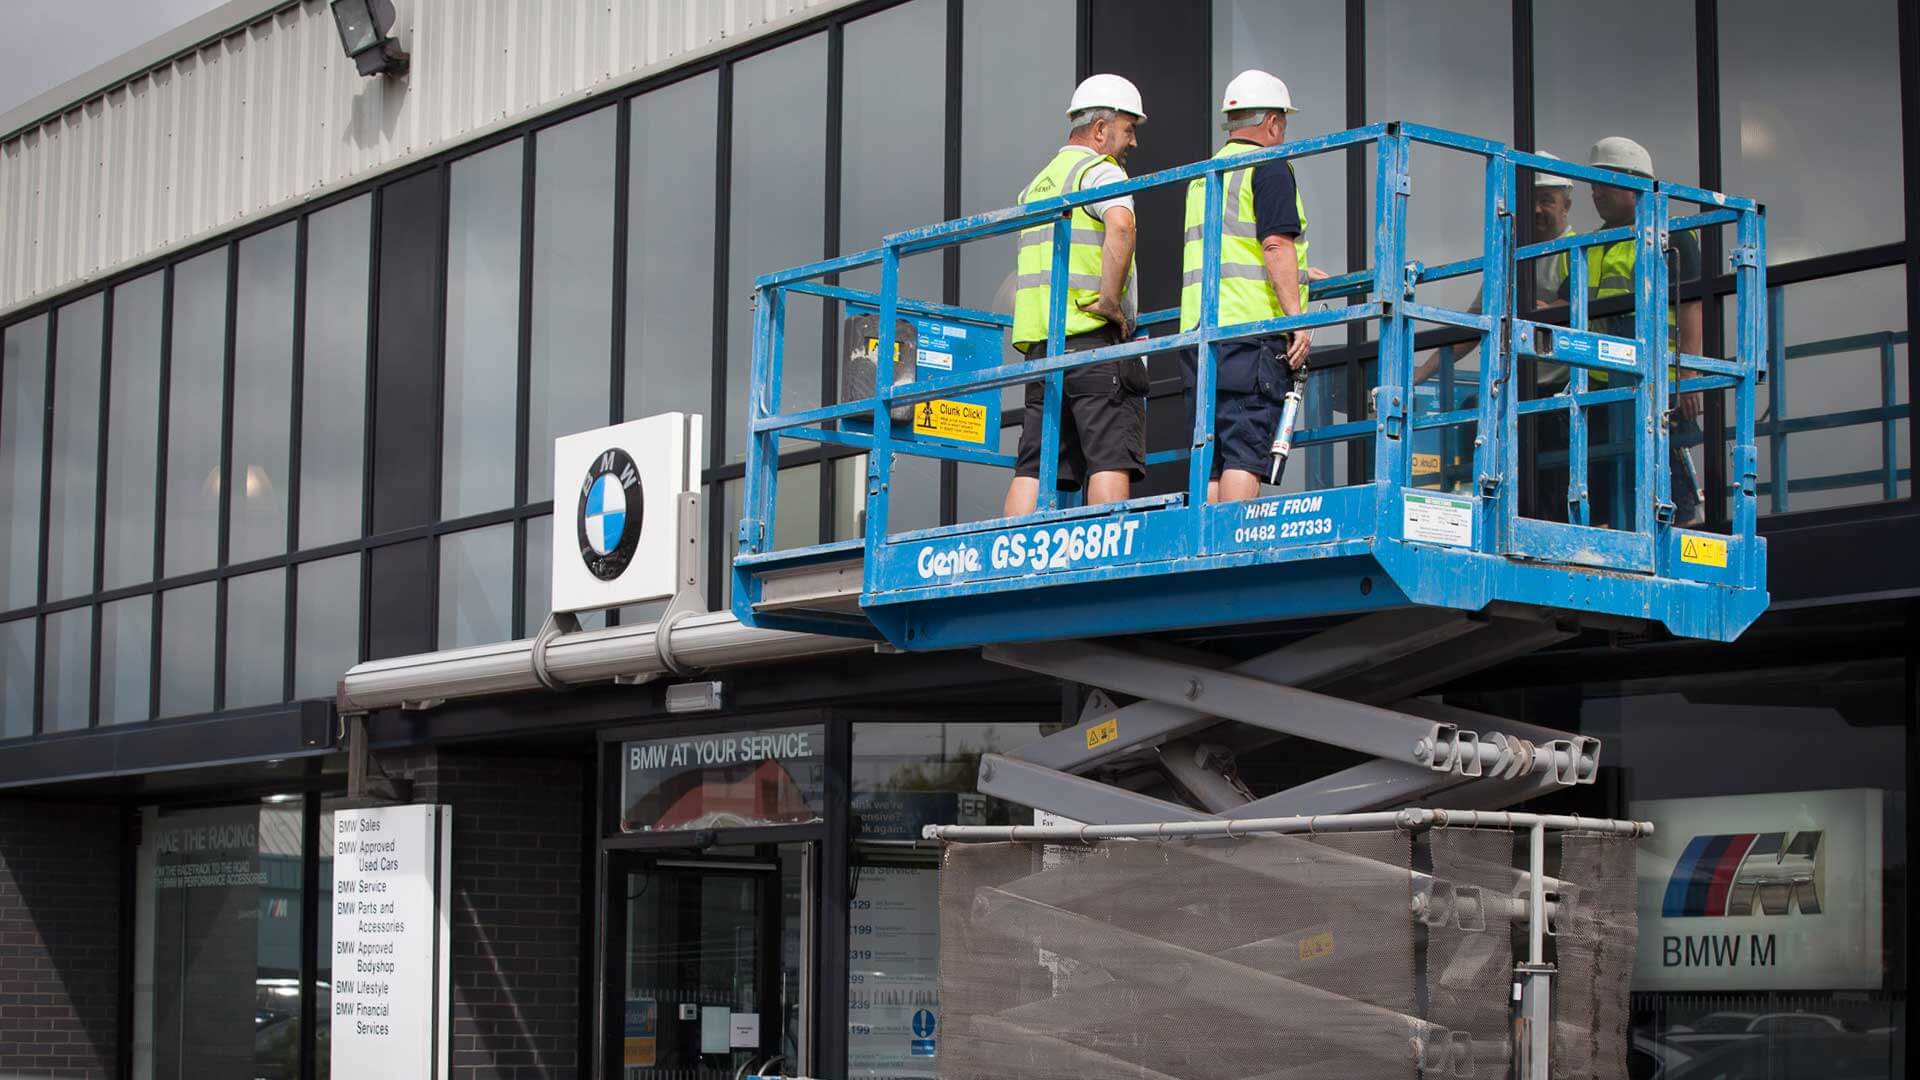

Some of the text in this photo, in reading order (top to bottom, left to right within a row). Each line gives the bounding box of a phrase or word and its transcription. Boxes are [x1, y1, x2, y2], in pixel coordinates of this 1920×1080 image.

[583, 451, 638, 497] BMW
[1245, 496, 1322, 519] HIRE FROM
[1235, 517, 1332, 543] 01482 227333
[918, 520, 1139, 578] Genie GS-3268RT
[631, 733, 812, 770] BMW AT YOUR SERVICE.
[961, 799, 987, 817] ER
[339, 819, 381, 833] BMW Sales
[183, 828, 206, 851] THE
[208, 824, 257, 849] RACING
[339, 839, 395, 856] BMW Approved
[359, 857, 399, 872] Used Cars
[338, 880, 387, 893] BMW Service
[338, 901, 394, 915] BMW Parts and
[358, 920, 405, 933] Accessories
[337, 941, 394, 956] BMW Approved
[1663, 934, 1776, 968] BMW M
[357, 959, 395, 975] Bodyshop
[337, 981, 389, 997] BMW Lifestyle
[336, 1002, 390, 1016] BMW Financial
[356, 1021, 390, 1035] Services
